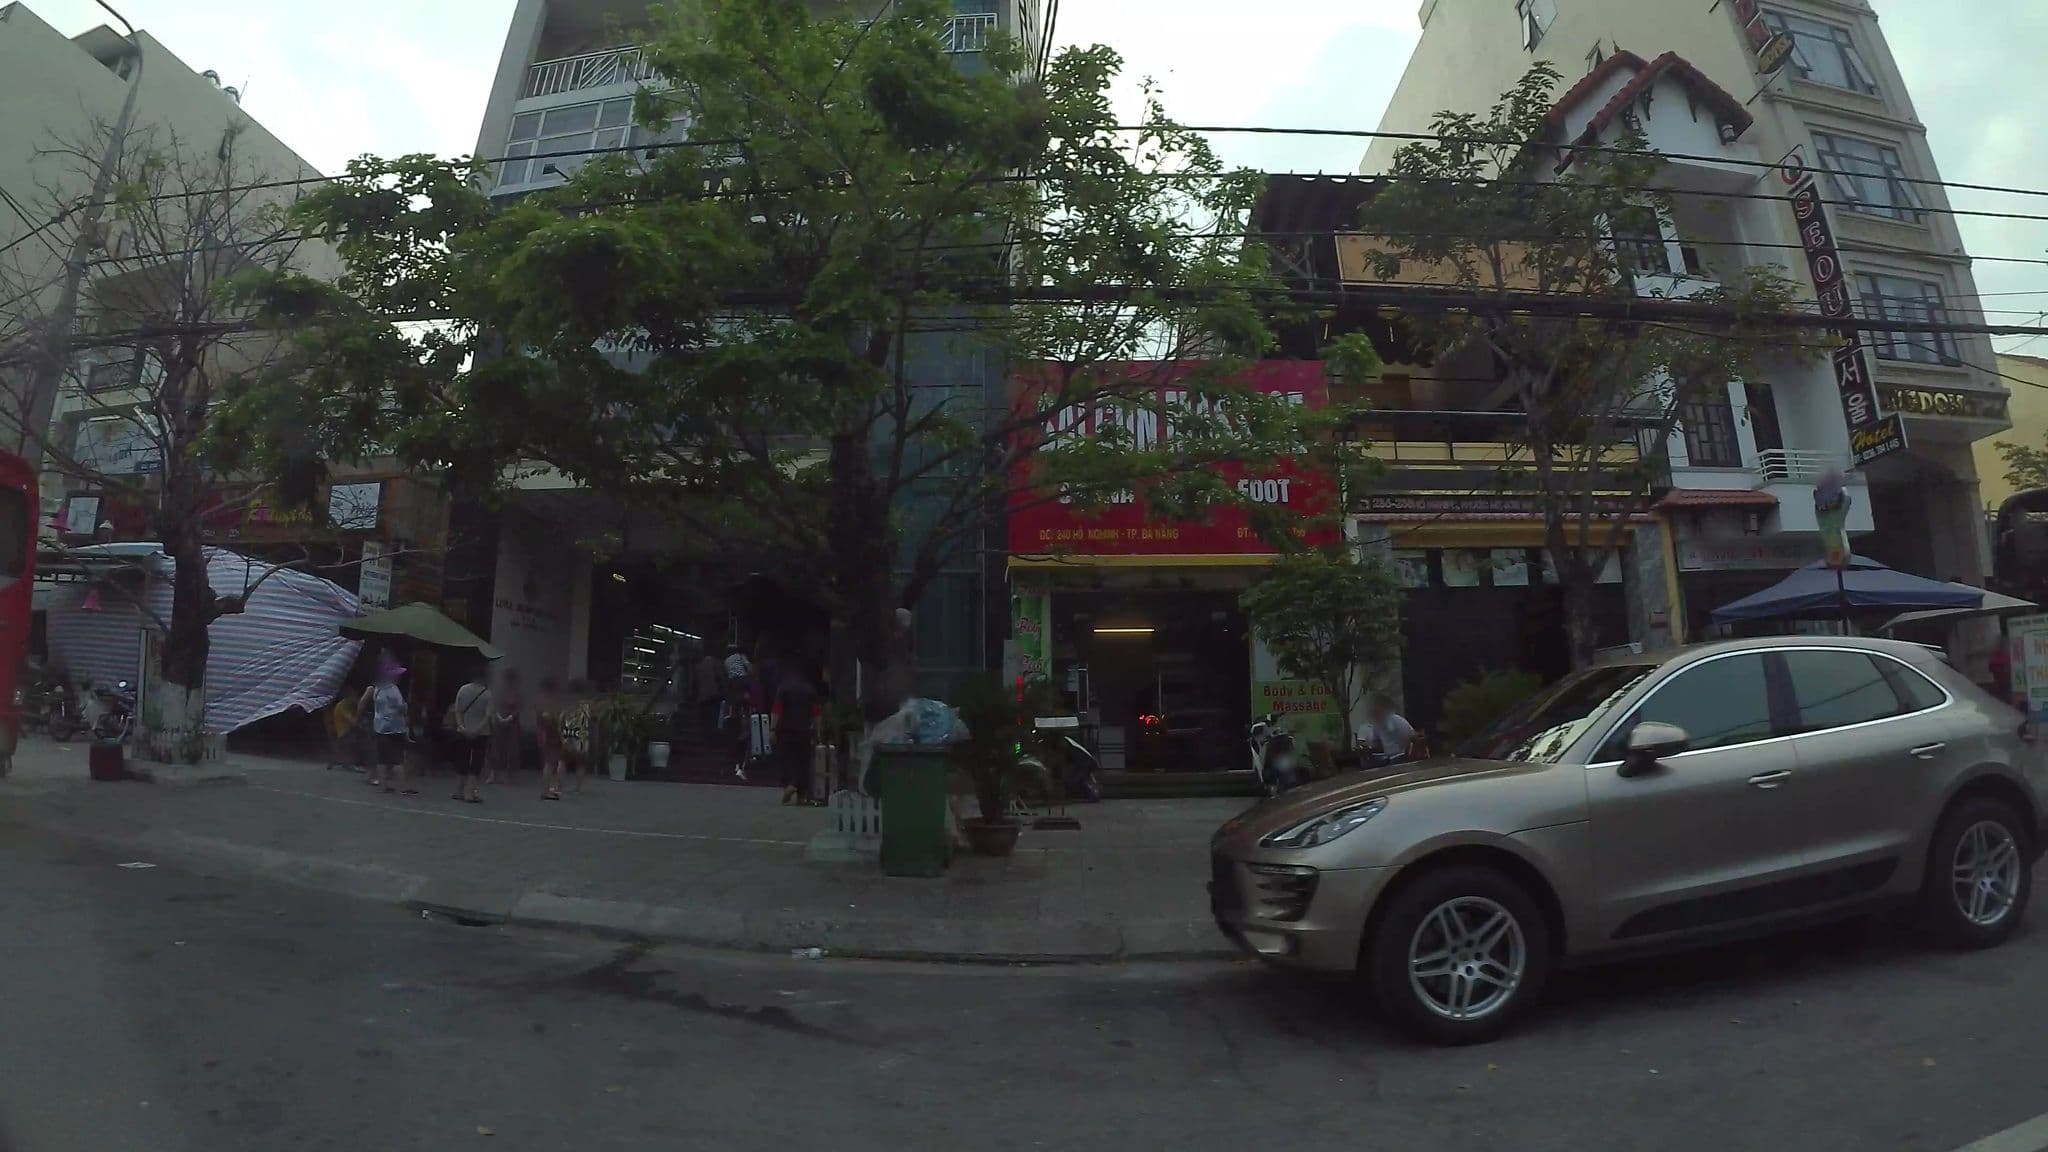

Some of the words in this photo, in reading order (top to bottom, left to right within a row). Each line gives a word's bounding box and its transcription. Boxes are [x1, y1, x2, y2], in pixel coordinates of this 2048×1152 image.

[1841, 361, 1869, 425] 서울
[1852, 418, 1895, 452] Hotel
[1237, 478, 1290, 503] FOOT
[1263, 685, 1293, 697] Body
[1272, 700, 1328, 713] Massage
